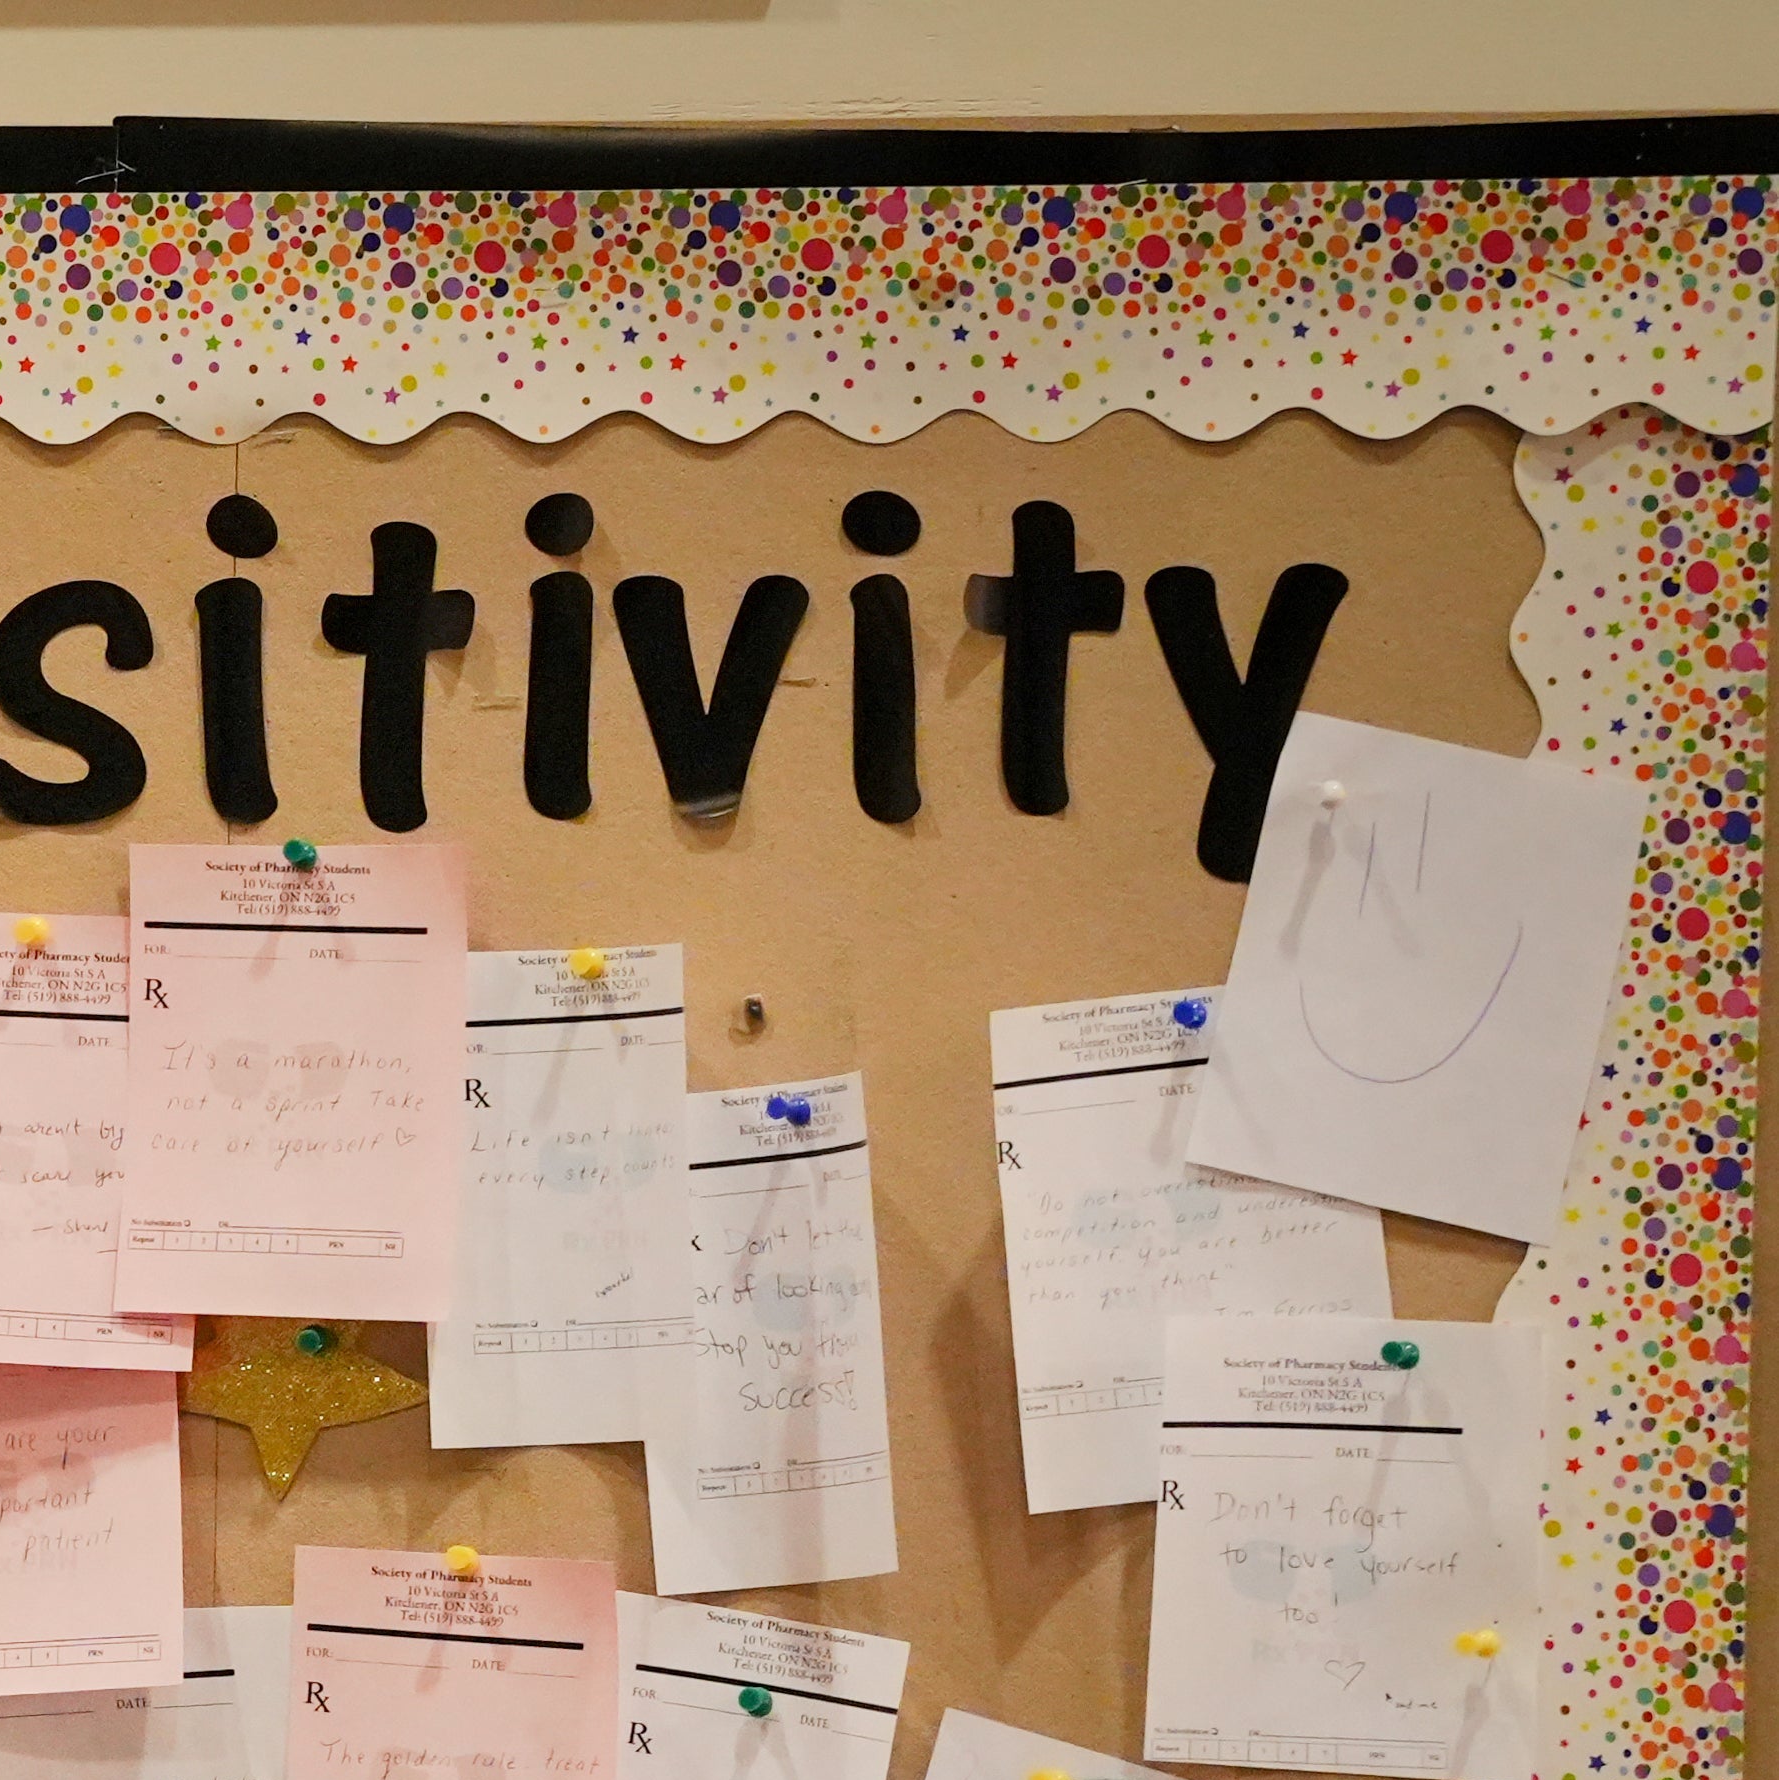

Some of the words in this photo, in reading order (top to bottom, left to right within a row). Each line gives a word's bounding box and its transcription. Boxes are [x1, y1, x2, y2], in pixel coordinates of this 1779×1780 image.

[237, 1054, 248, 1067] a
[168, 1096, 206, 1110] not
[231, 1098, 242, 1110] a
[277, 1133, 387, 1171] yourself
[21, 1168, 71, 1183] scare
[96, 1169, 126, 1187] you
[1209, 1492, 1297, 1523] Don't
[1324, 1496, 1407, 1554] forget
[1219, 1544, 1247, 1565] to
[1279, 1546, 1334, 1573] love
[1359, 1553, 1460, 1585] yourself
